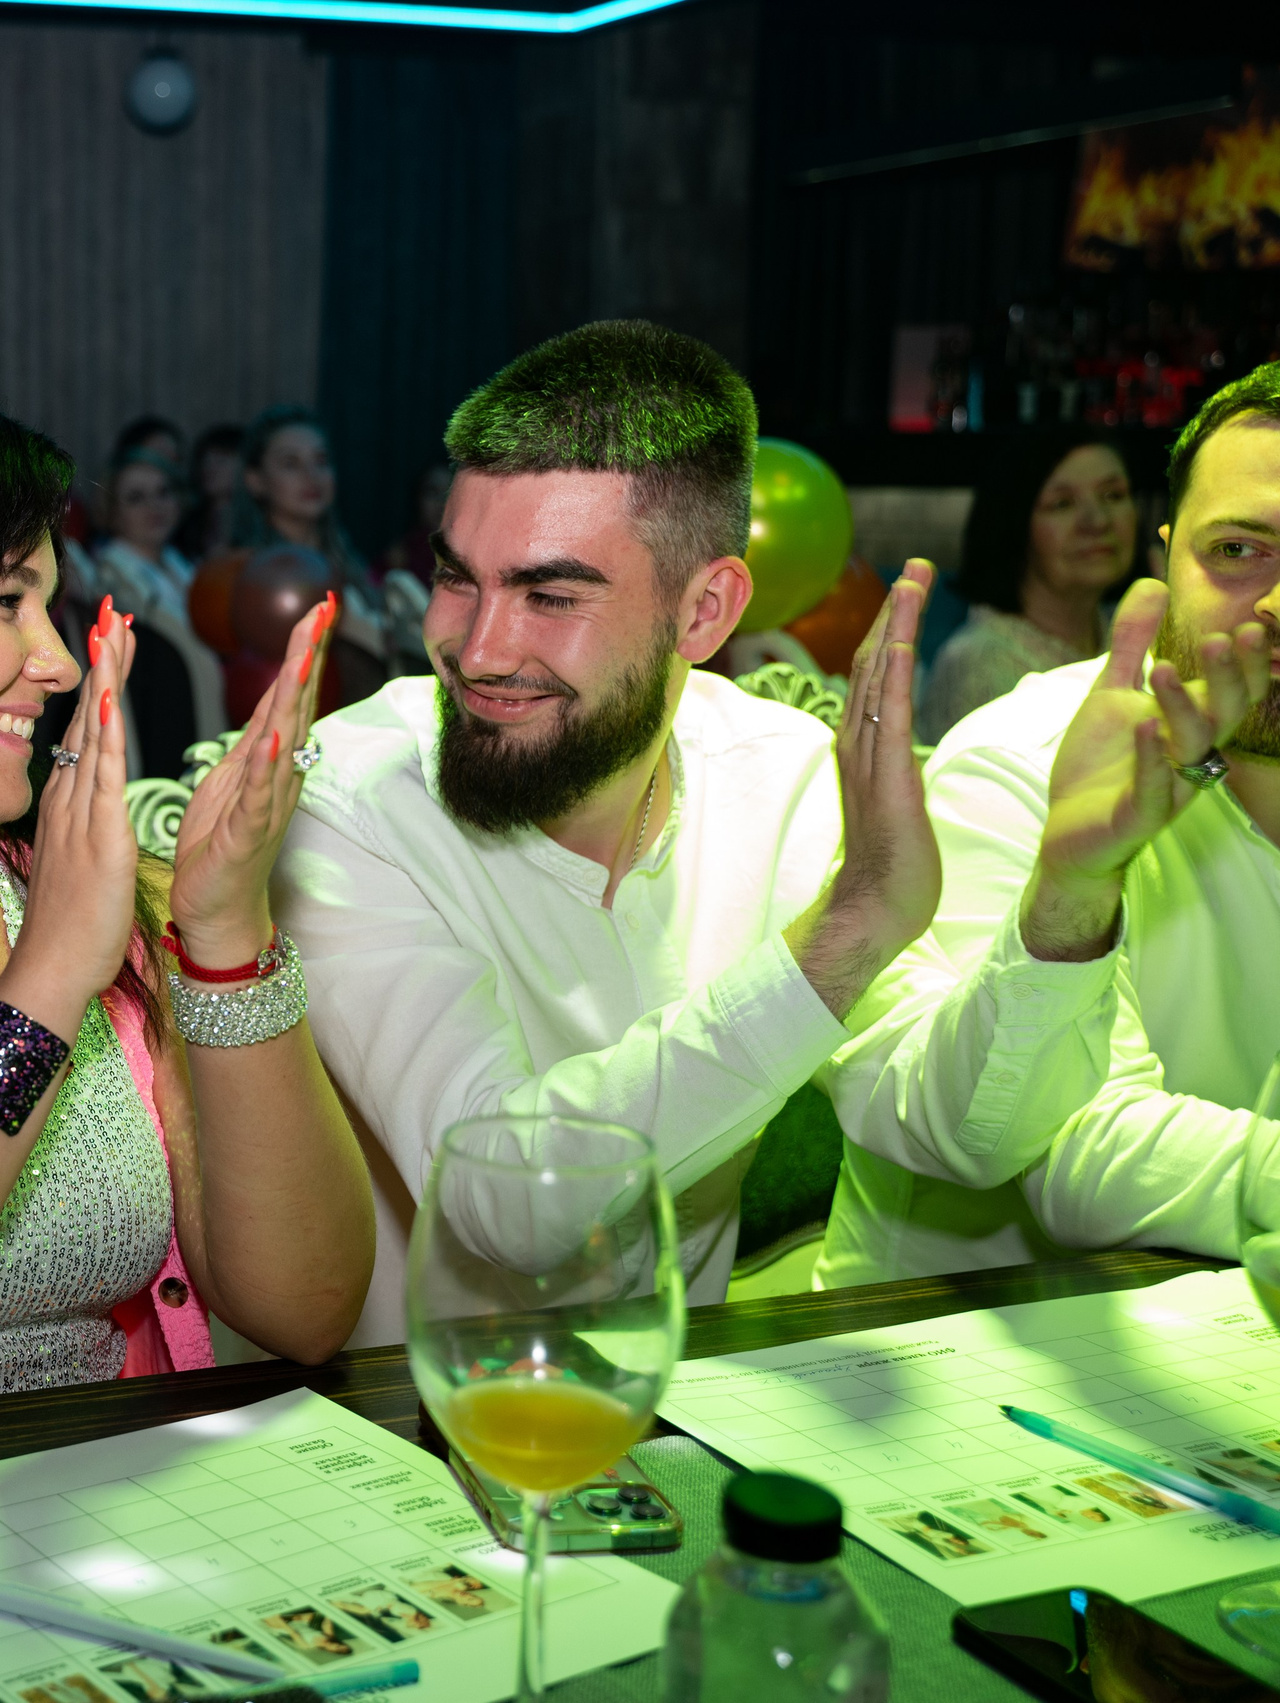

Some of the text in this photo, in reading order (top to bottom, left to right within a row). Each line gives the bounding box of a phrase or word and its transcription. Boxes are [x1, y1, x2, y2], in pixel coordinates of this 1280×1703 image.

[819, 1351, 866, 1368] участниц
[856, 1346, 956, 1370] ФИО члена жюри
[866, 1346, 894, 1358] выход
[753, 1360, 817, 1375] оценивается
[287, 1437, 327, 1452] баллы
[294, 1440, 334, 1456] Общие
[311, 1450, 359, 1467] платьях
[316, 1453, 369, 1472] вечерних
[333, 1456, 377, 1473] Дефиле
[348, 1469, 413, 1491] купальниках
[374, 1474, 412, 1490] Дефиле
[393, 1494, 431, 1509] белом
[402, 1496, 446, 1514] Дефиле
[424, 1516, 455, 1529] этапа
[439, 1516, 477, 1530] баллы
[440, 1522, 481, 1539] Общие
